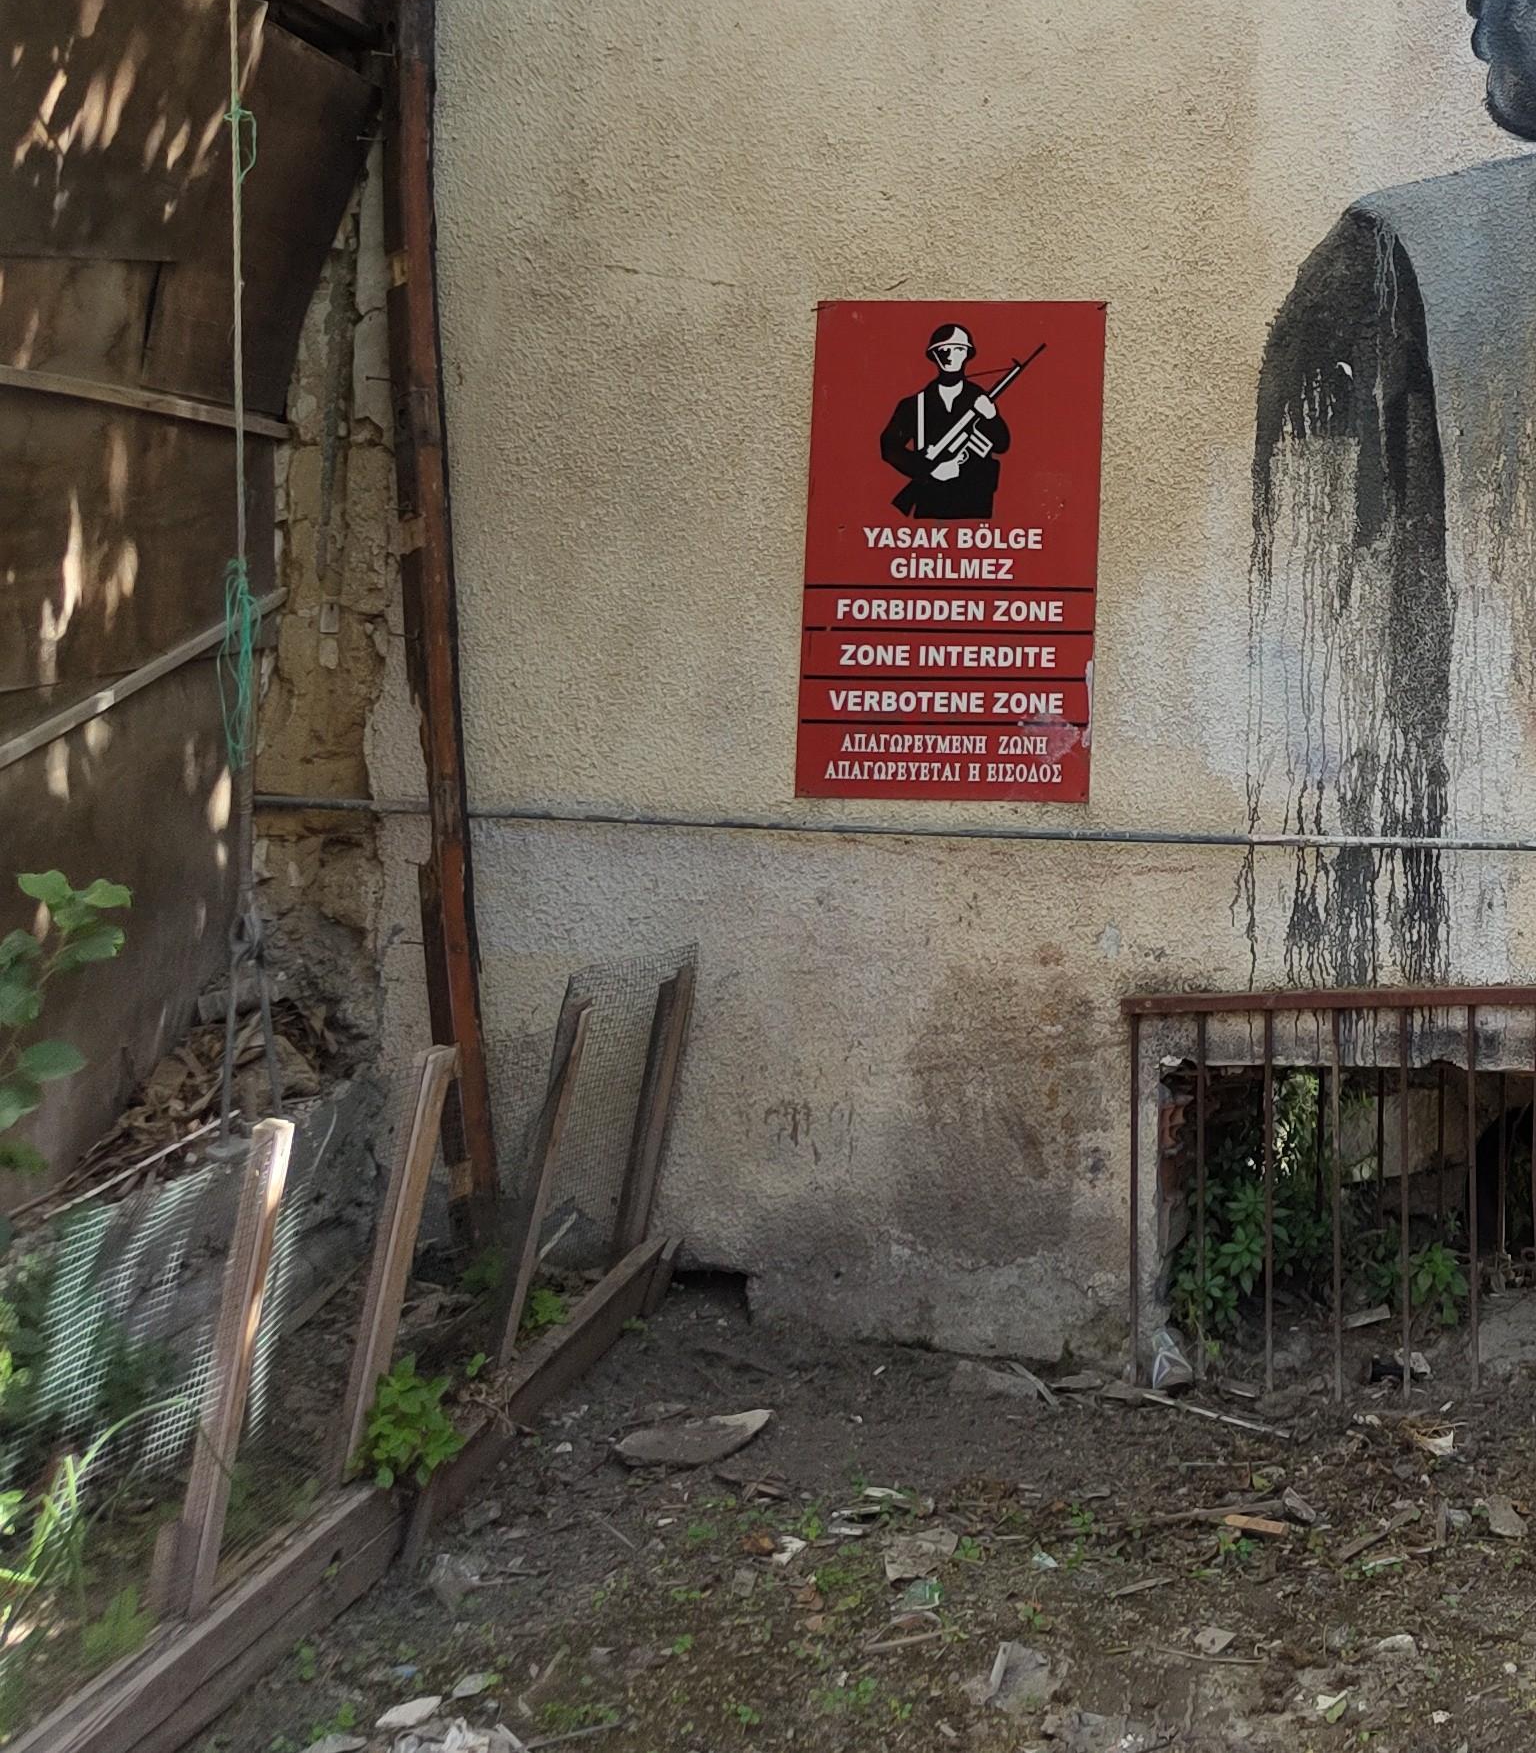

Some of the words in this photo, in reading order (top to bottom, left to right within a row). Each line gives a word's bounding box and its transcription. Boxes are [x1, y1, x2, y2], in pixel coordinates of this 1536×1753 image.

[863, 527, 950, 548] YASAK
[957, 523, 1043, 550] BÖLGE
[890, 552, 1014, 580] GİRİLMEZ
[836, 598, 985, 621] FORBIDDEN
[992, 600, 1064, 622] ZONE
[839, 644, 911, 666] ZONE
[918, 645, 1056, 668] INTERDITE
[828, 690, 985, 713] VERBOTENE
[992, 692, 1064, 715] ZONE
[840, 733, 987, 754] ΑΠΑΓΩΡΕΥΜΕΝΗ
[997, 735, 1048, 755] ΖΩΝΗ
[824, 760, 961, 782] ΑΠΑΓΩΡΕΥΕΤΑΙ
[967, 763, 981, 782] Η
[986, 763, 1062, 783] ΕΙΣΟΔΟΣ
